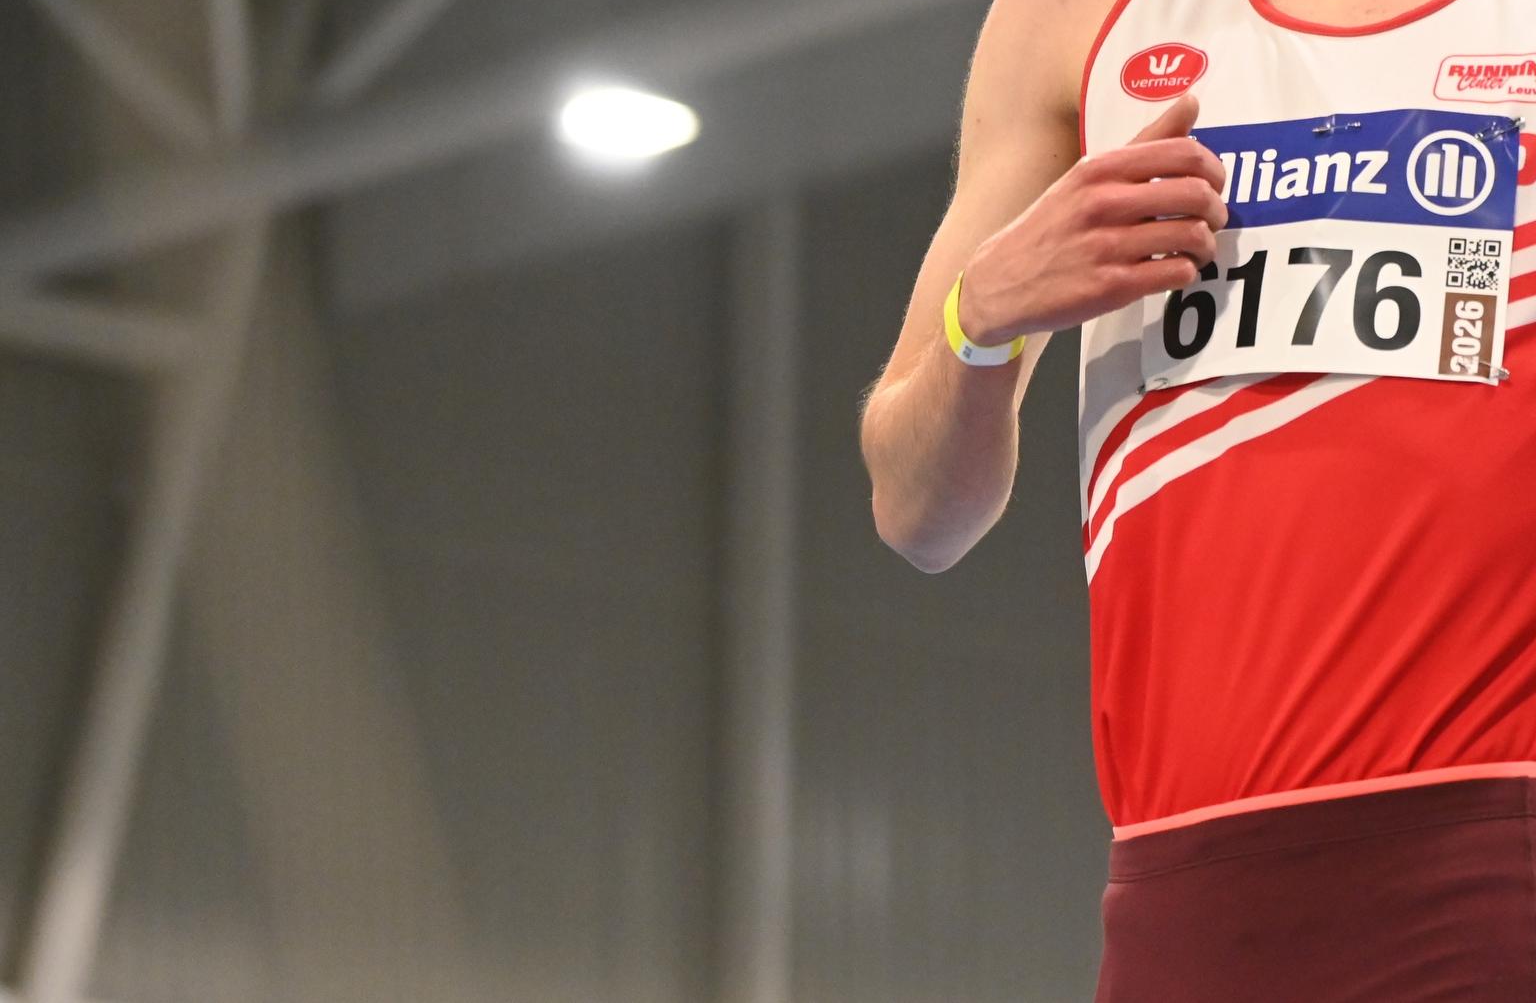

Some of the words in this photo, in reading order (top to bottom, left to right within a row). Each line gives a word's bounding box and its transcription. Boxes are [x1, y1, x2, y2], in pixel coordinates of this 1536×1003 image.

[1131, 77, 1191, 89] vermarc
[1219, 148, 1389, 204] llianz
[1163, 246, 1423, 360] 6176
[1450, 300, 1485, 375] 2026
